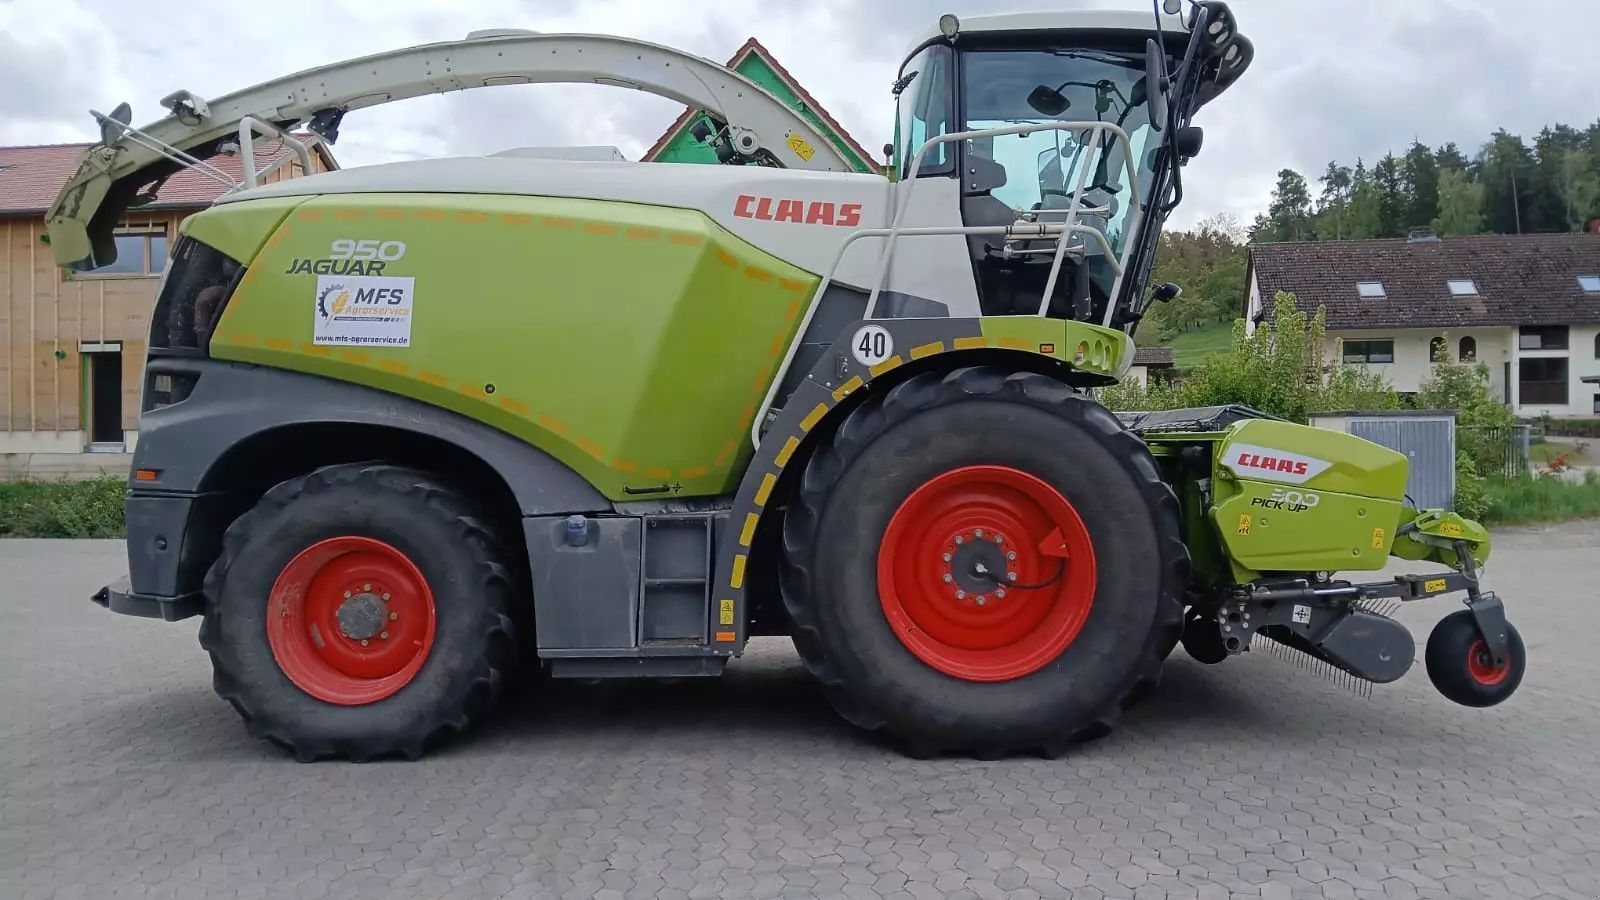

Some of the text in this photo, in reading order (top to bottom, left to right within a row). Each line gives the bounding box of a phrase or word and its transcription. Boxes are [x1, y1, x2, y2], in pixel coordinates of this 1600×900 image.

[733, 194, 863, 227] CLAAS
[330, 239, 406, 261] 950
[285, 259, 386, 277] JAGUAR
[354, 288, 404, 305] MFS
[345, 306, 410, 317] Agrarservice
[315, 335, 409, 345] www.mfs-agrarservice.de
[858, 332, 886, 358] 40
[1237, 453, 1309, 475] CLAAS
[1251, 497, 1308, 513] PICK UP
